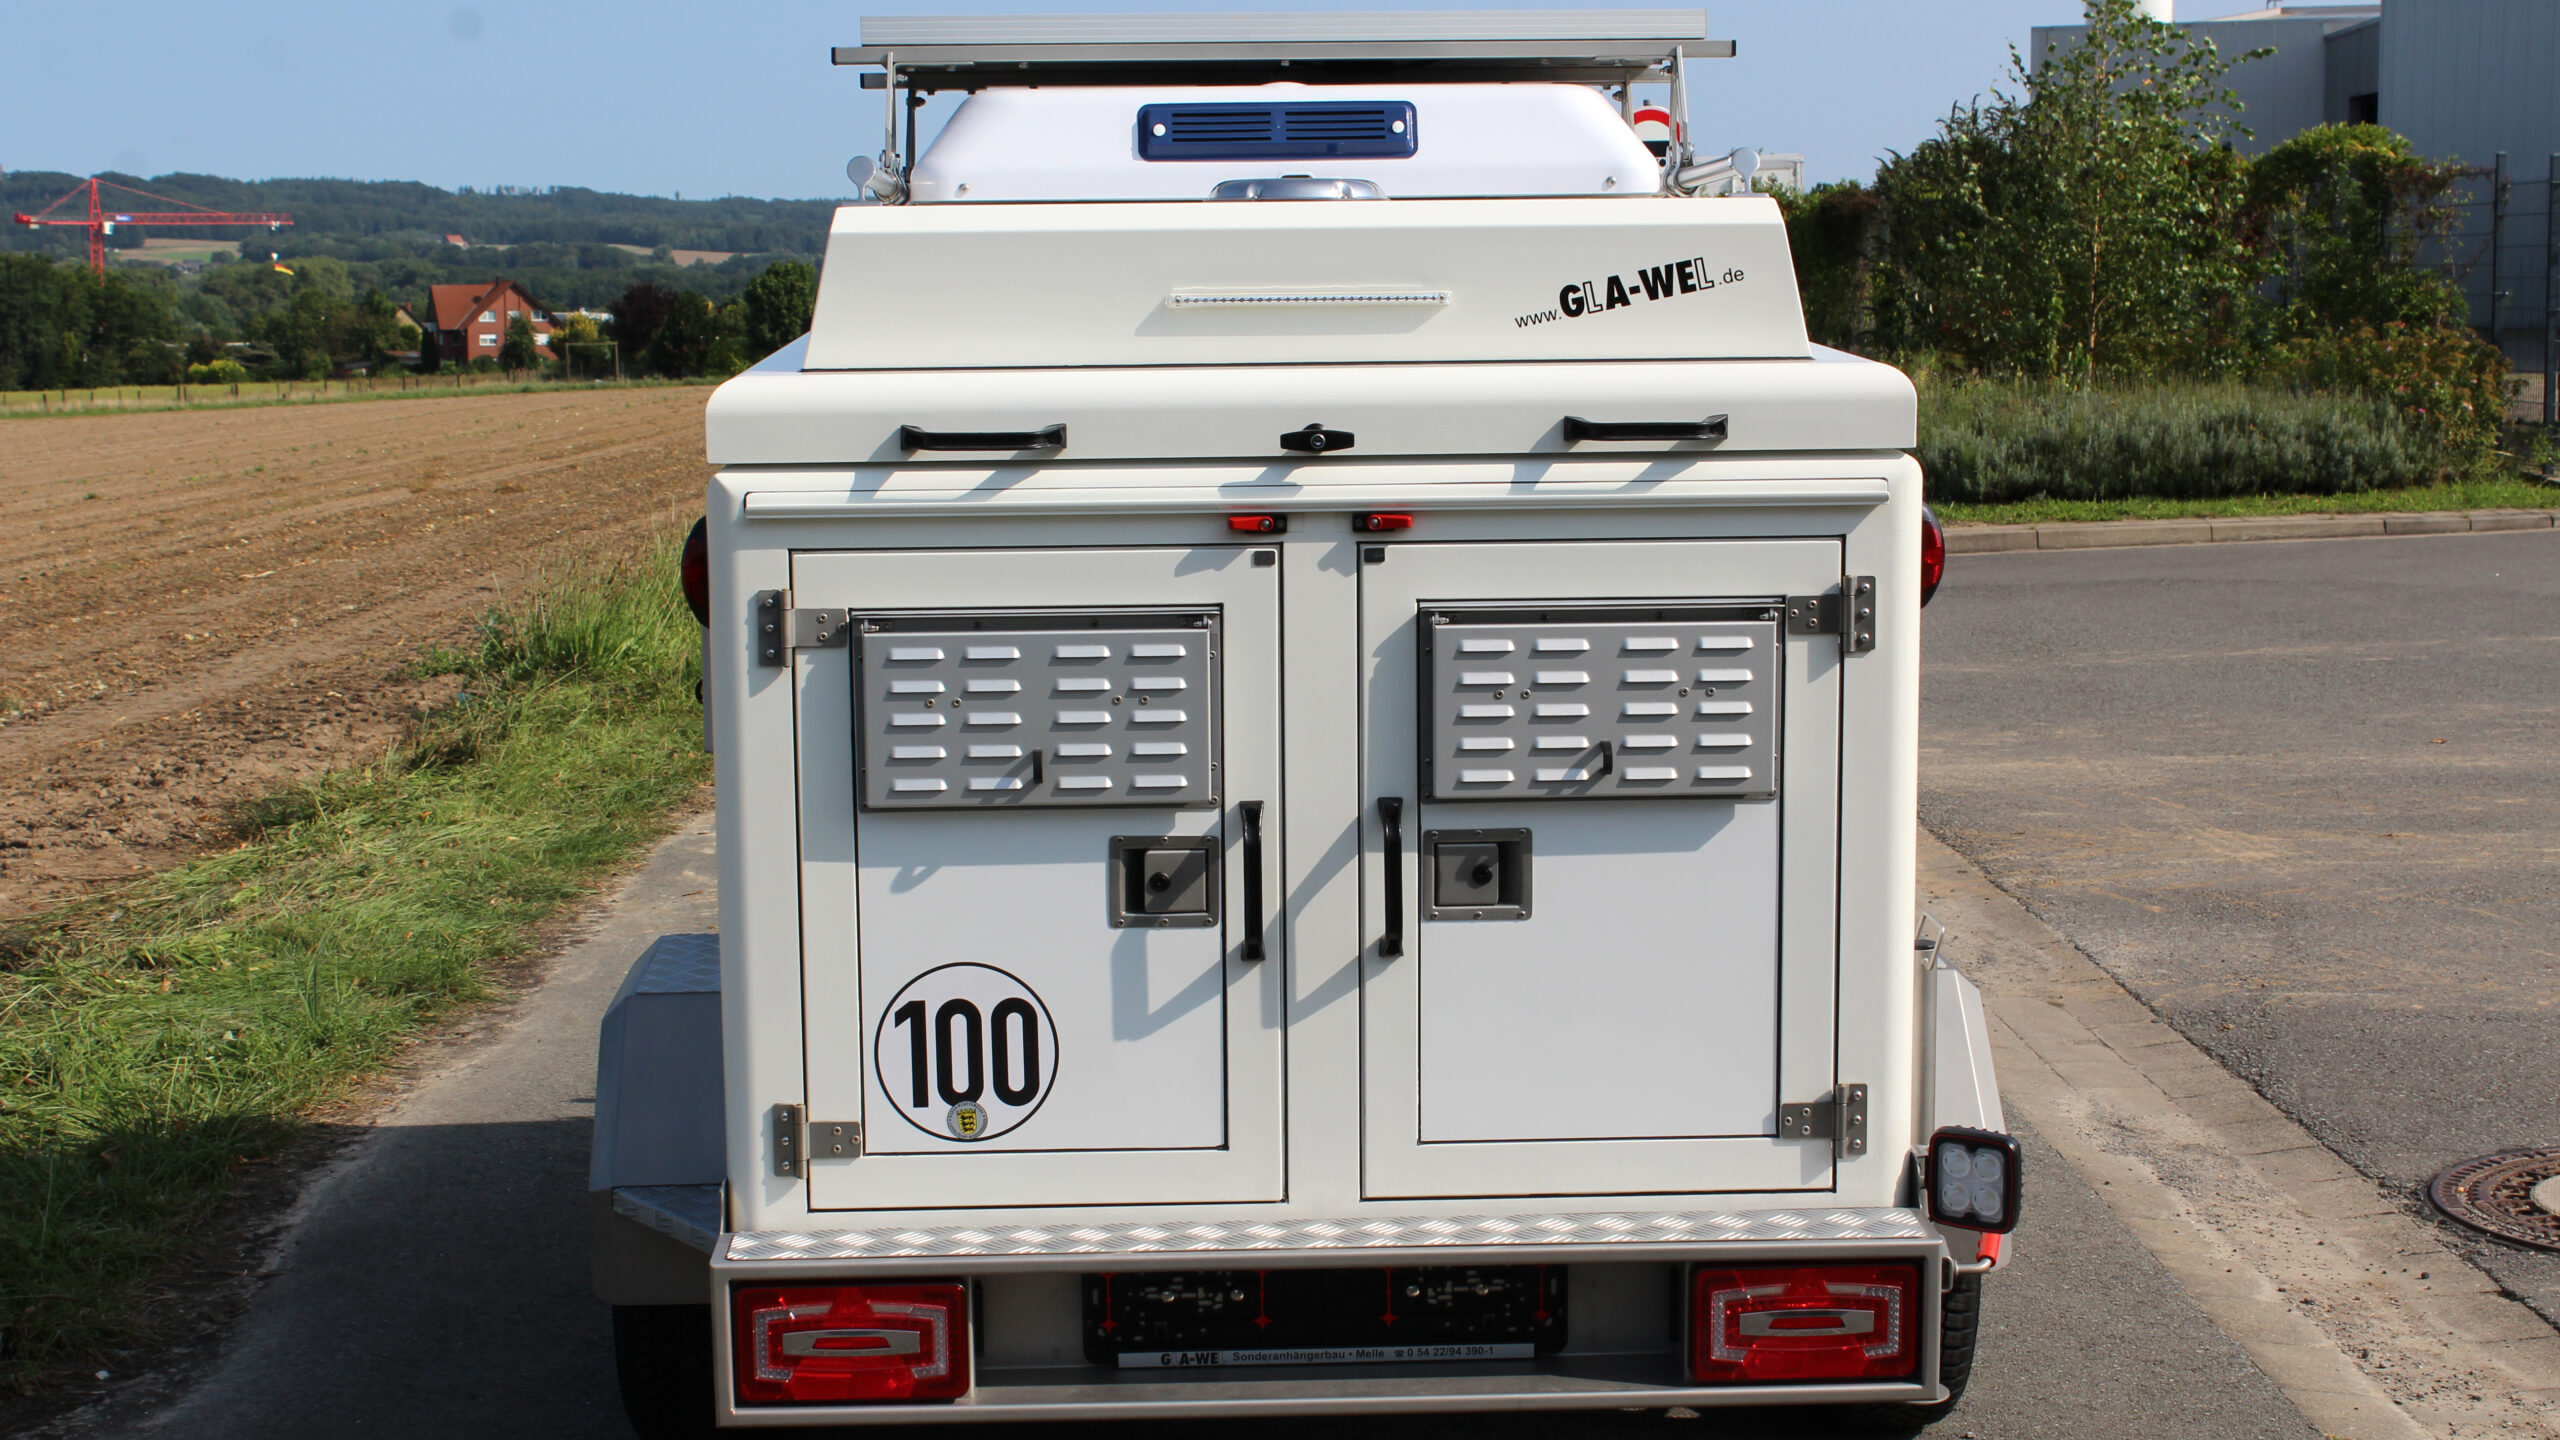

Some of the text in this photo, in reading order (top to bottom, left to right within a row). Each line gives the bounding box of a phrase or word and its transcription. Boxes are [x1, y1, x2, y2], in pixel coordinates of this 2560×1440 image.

[1514, 257, 1745, 328] www.GLA-WEL.de
[895, 997, 1040, 1108] 100
[1232, 1350, 1345, 1362] Sonderanhängerbau
[1356, 1349, 1385, 1359] Melle
[1417, 1347, 1430, 1357] 54
[1433, 1346, 1462, 1357] 22/94
[1465, 1345, 1494, 1356] 390-1
